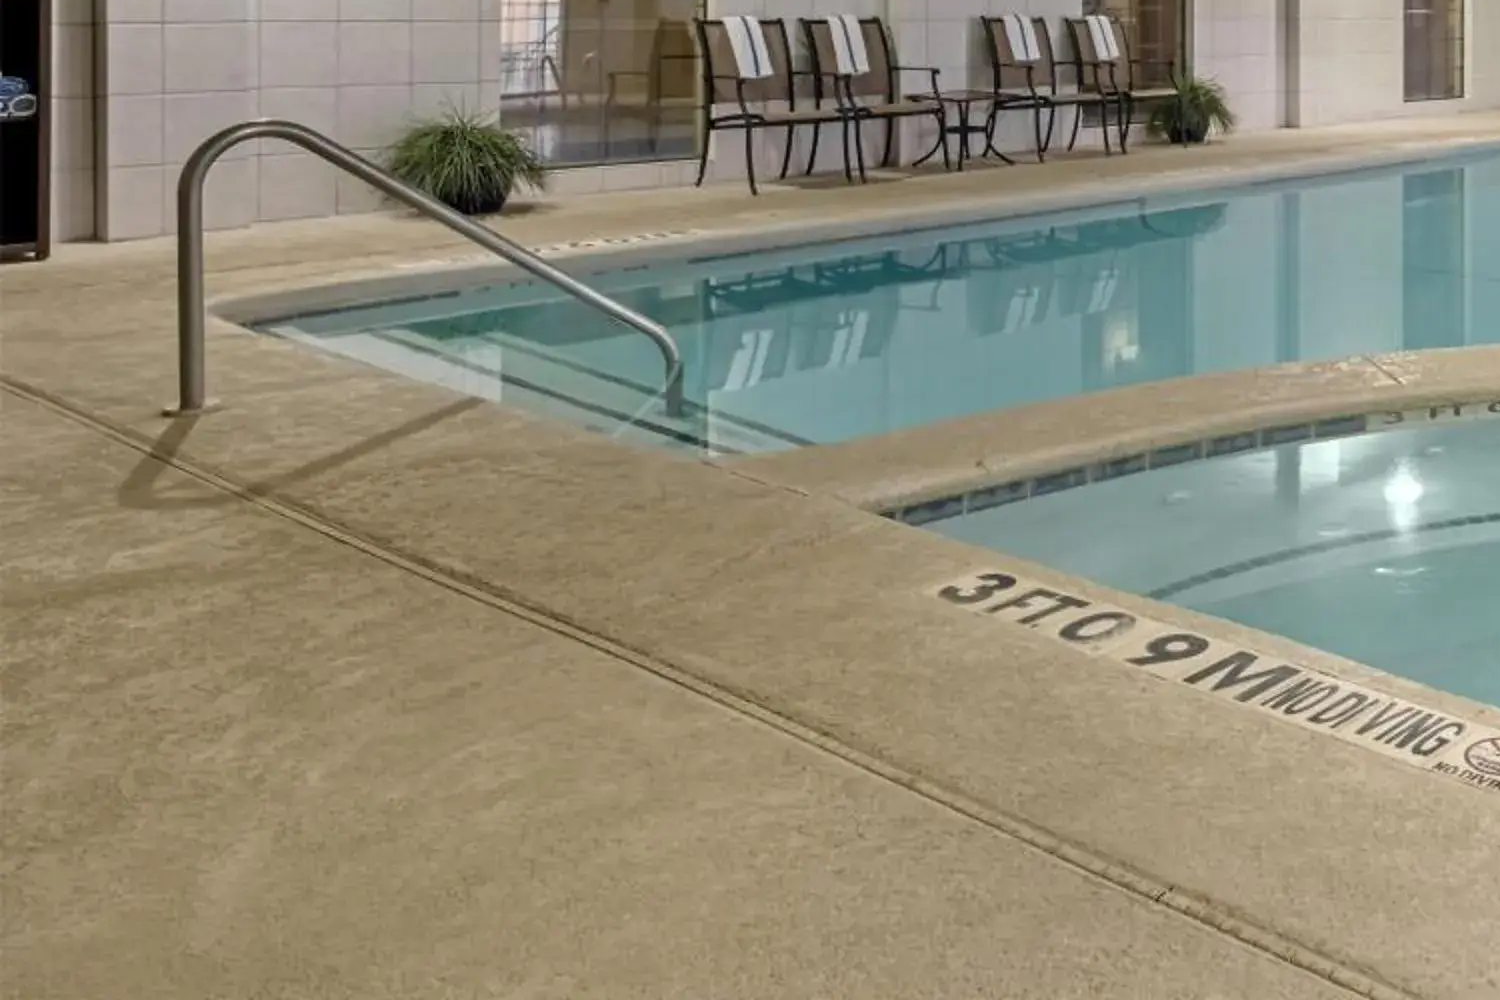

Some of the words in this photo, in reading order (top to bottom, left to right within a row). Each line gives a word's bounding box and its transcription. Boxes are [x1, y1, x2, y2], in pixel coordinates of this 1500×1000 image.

[938, 573, 1017, 604] 3
[1183, 651, 1301, 702] M
[1260, 677, 1340, 715] NO
[1307, 691, 1466, 757] DIVING
[1432, 761, 1459, 775] NO
